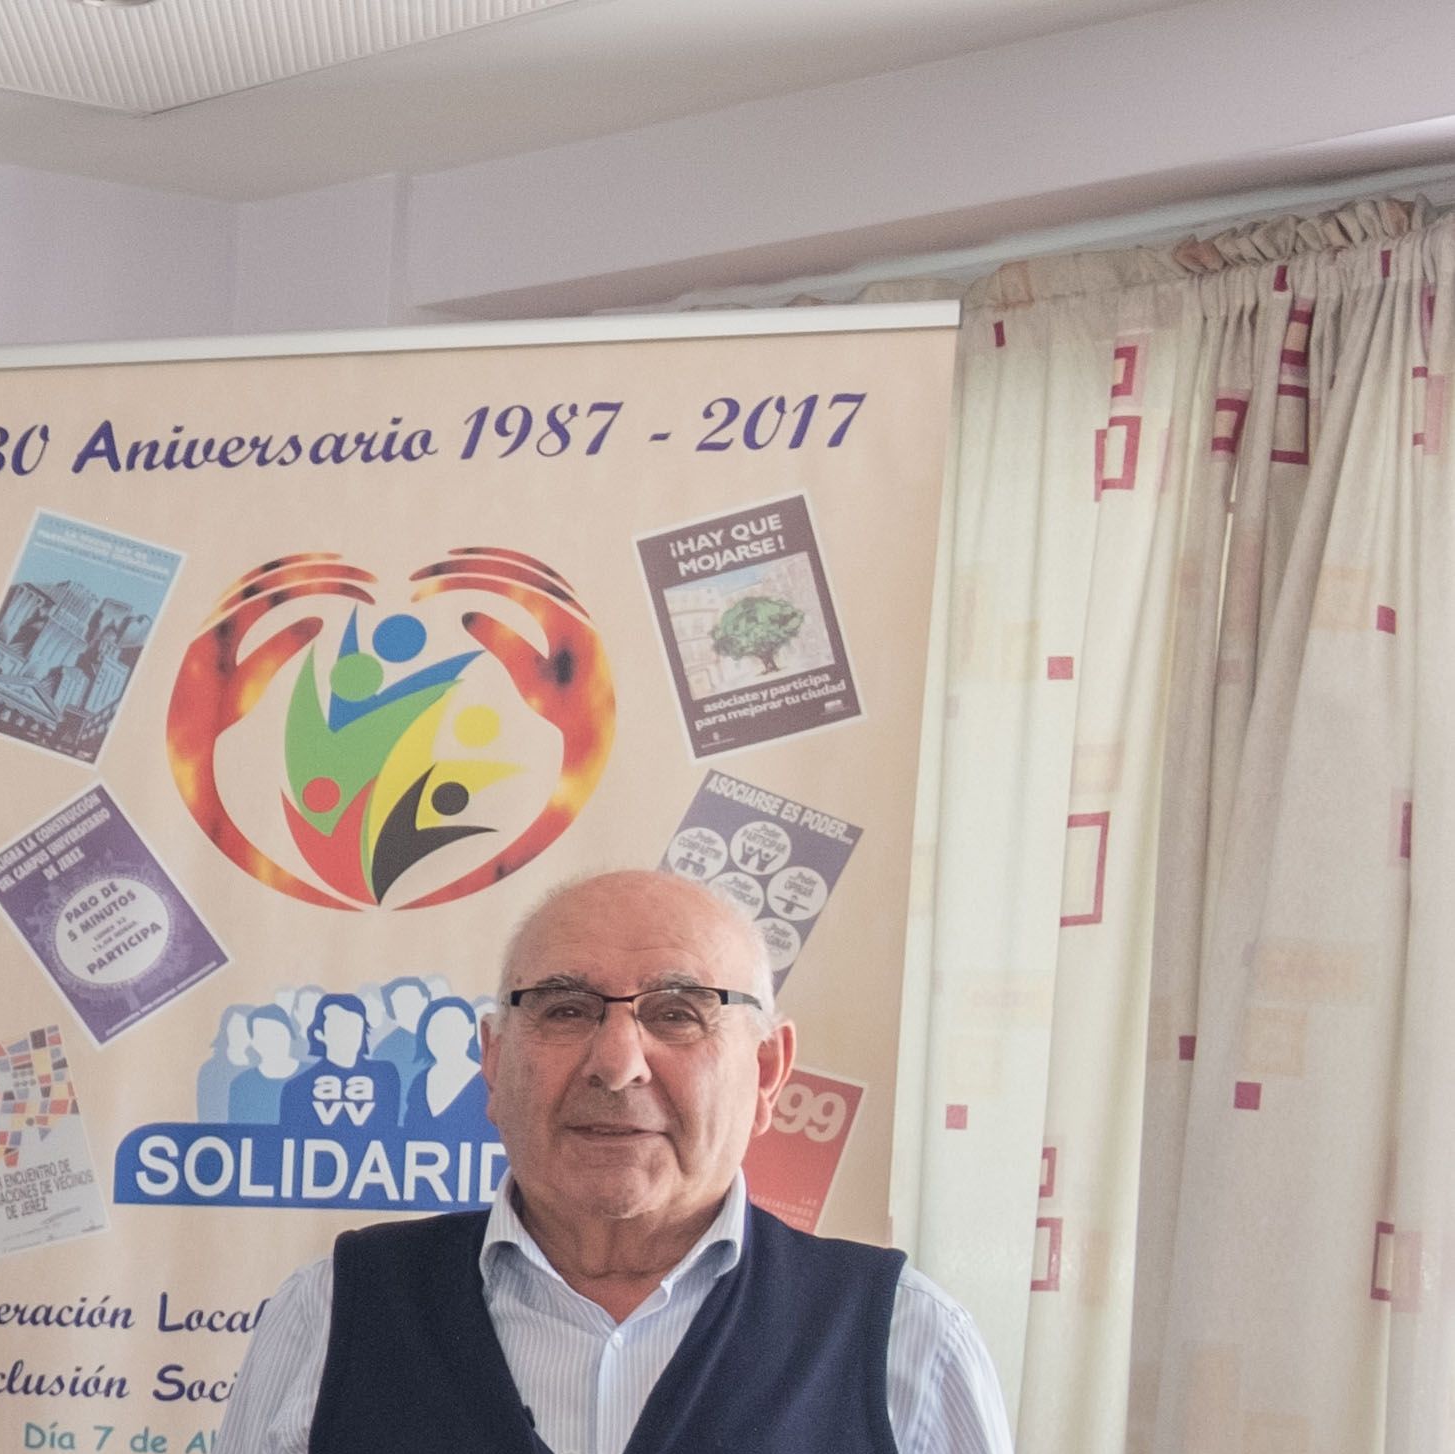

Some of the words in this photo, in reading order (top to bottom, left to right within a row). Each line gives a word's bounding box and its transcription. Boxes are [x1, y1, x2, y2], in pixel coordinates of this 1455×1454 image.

[71, 417, 439, 474] Aniversario
[460, 402, 624, 460] 1987
[695, 391, 868, 453] 2017
[731, 513, 783, 541] QUE
[759, 690, 768, 703] y
[769, 673, 831, 699] participa
[694, 713, 727, 731] para
[727, 699, 784, 720] mejorar
[784, 694, 801, 707] tu
[801, 679, 847, 701] ciudad
[705, 773, 784, 817] ASOCIARSE
[780, 802, 802, 824] ES
[21, 837, 38, 853] LA
[65, 895, 100, 924] PARO
[100, 881, 119, 898] DE
[79, 889, 136, 934] MINUTOS
[86, 922, 162, 975] PARTICIPA
[3, 1161, 58, 1188] ENCUENTRO
[57, 1157, 72, 1174] DE
[40, 1179, 53, 1195] DE
[5, 1204, 19, 1220] DE
[24, 1421, 76, 1450] Día
[93, 1425, 115, 1451] 7
[129, 1426, 168, 1454] de
